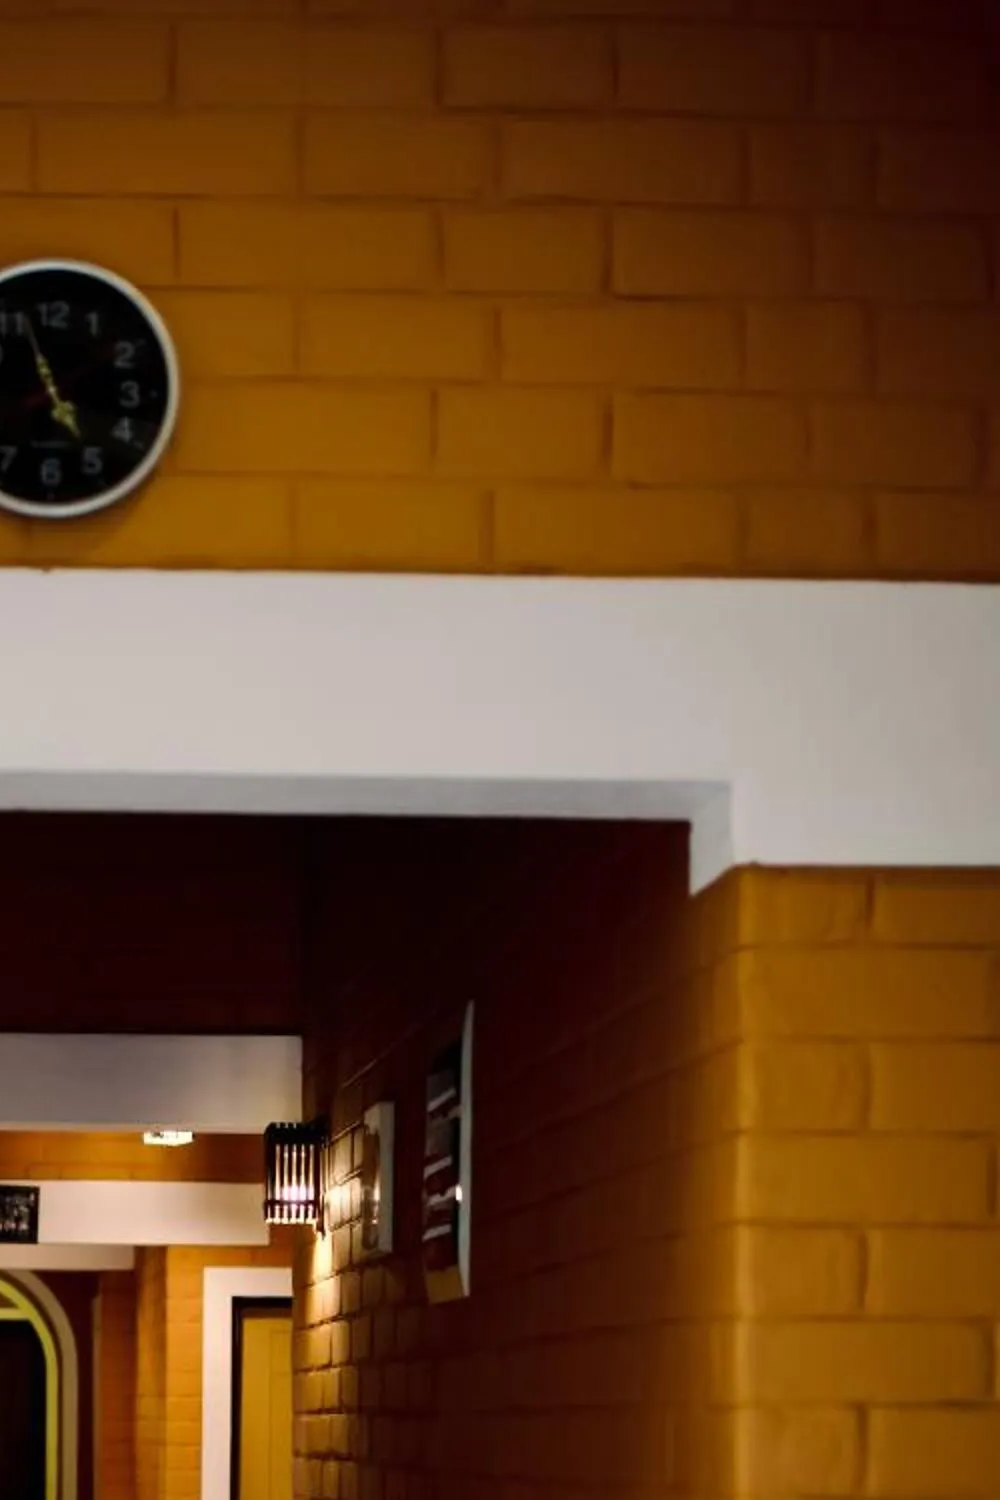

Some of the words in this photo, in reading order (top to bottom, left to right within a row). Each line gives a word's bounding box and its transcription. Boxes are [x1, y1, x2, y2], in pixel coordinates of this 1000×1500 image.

[37, 300, 71, 330] 12
[85, 311, 100, 338] 1
[113, 340, 138, 369] 2
[118, 379, 141, 409] 3
[110, 416, 135, 443] 4
[39, 456, 63, 488] 6
[80, 446, 105, 476] 5
